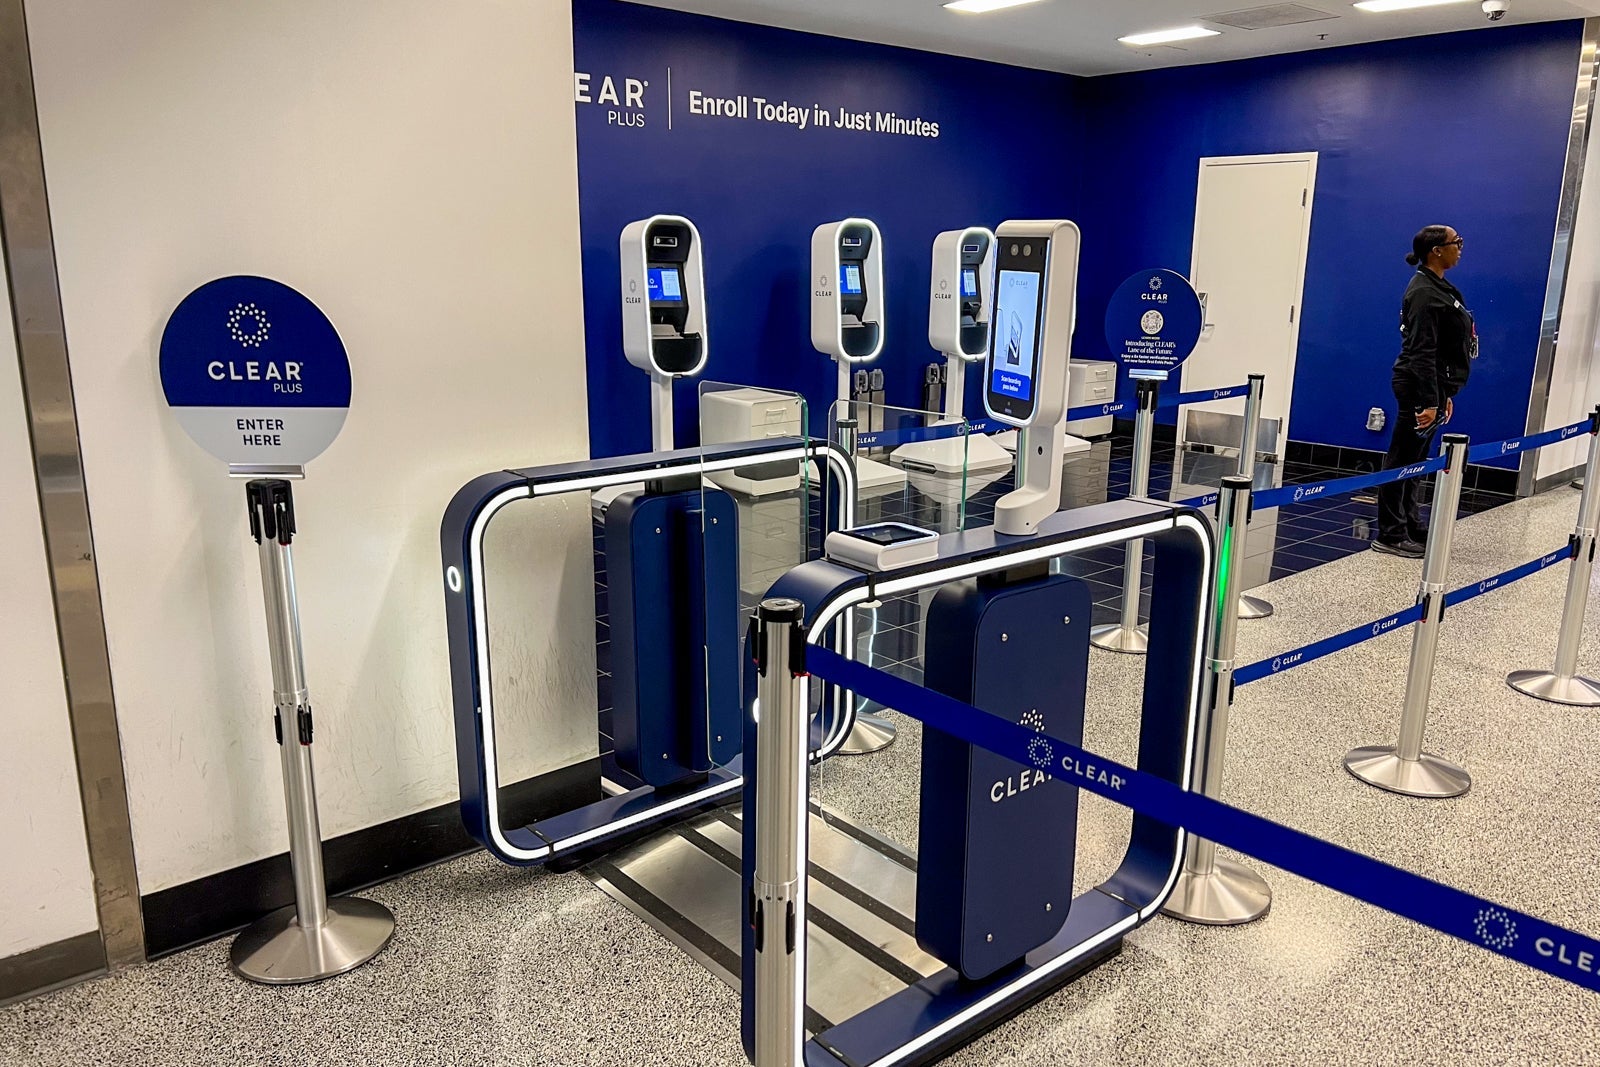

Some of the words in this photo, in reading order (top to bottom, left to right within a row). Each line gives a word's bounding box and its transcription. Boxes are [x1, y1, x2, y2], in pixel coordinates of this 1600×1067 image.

[608, 110, 645, 128] PLUS
[689, 90, 748, 118] Enroll
[753, 98, 810, 129] Today
[814, 104, 830, 126] in
[834, 107, 872, 132] Just
[875, 112, 940, 138] Minutes
[1125, 340, 1154, 348] Introducing
[208, 361, 303, 380] CLEAR
[274, 384, 302, 393] PLUS
[236, 419, 284, 430] ENTER
[243, 434, 281, 446] HERE
[1304, 486, 1325, 496] CLEAR
[1381, 618, 1398, 629] CLEAR
[1283, 653, 1302, 665] CLEAR
[1062, 756, 1126, 790] CLEAR
[990, 770, 1052, 802] CLEA
[1535, 937, 1600, 976] CLE
